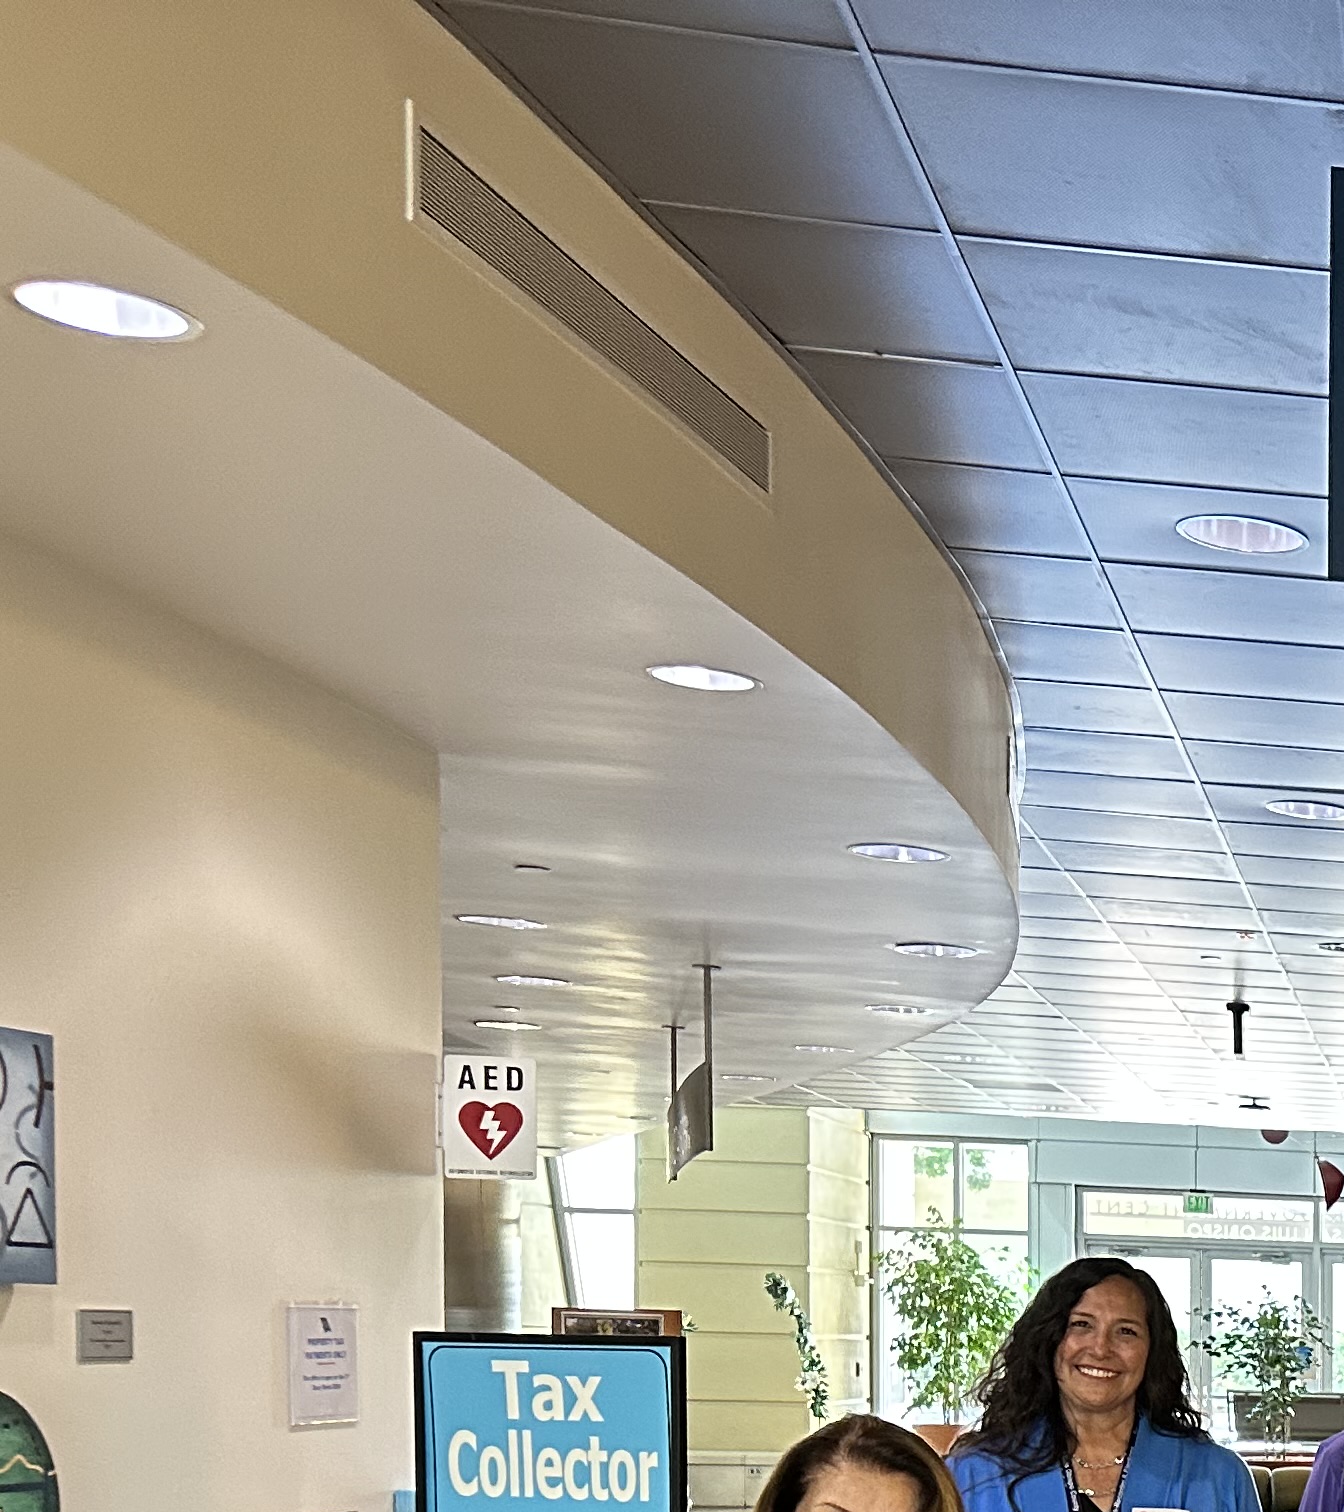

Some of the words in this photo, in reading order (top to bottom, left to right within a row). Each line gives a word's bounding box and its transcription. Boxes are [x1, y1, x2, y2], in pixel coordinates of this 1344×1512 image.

[457, 1064, 524, 1091] AED
[1187, 1195, 1210, 1211] EXIT
[490, 1360, 604, 1422] Tax
[448, 1429, 658, 1503] Collector
